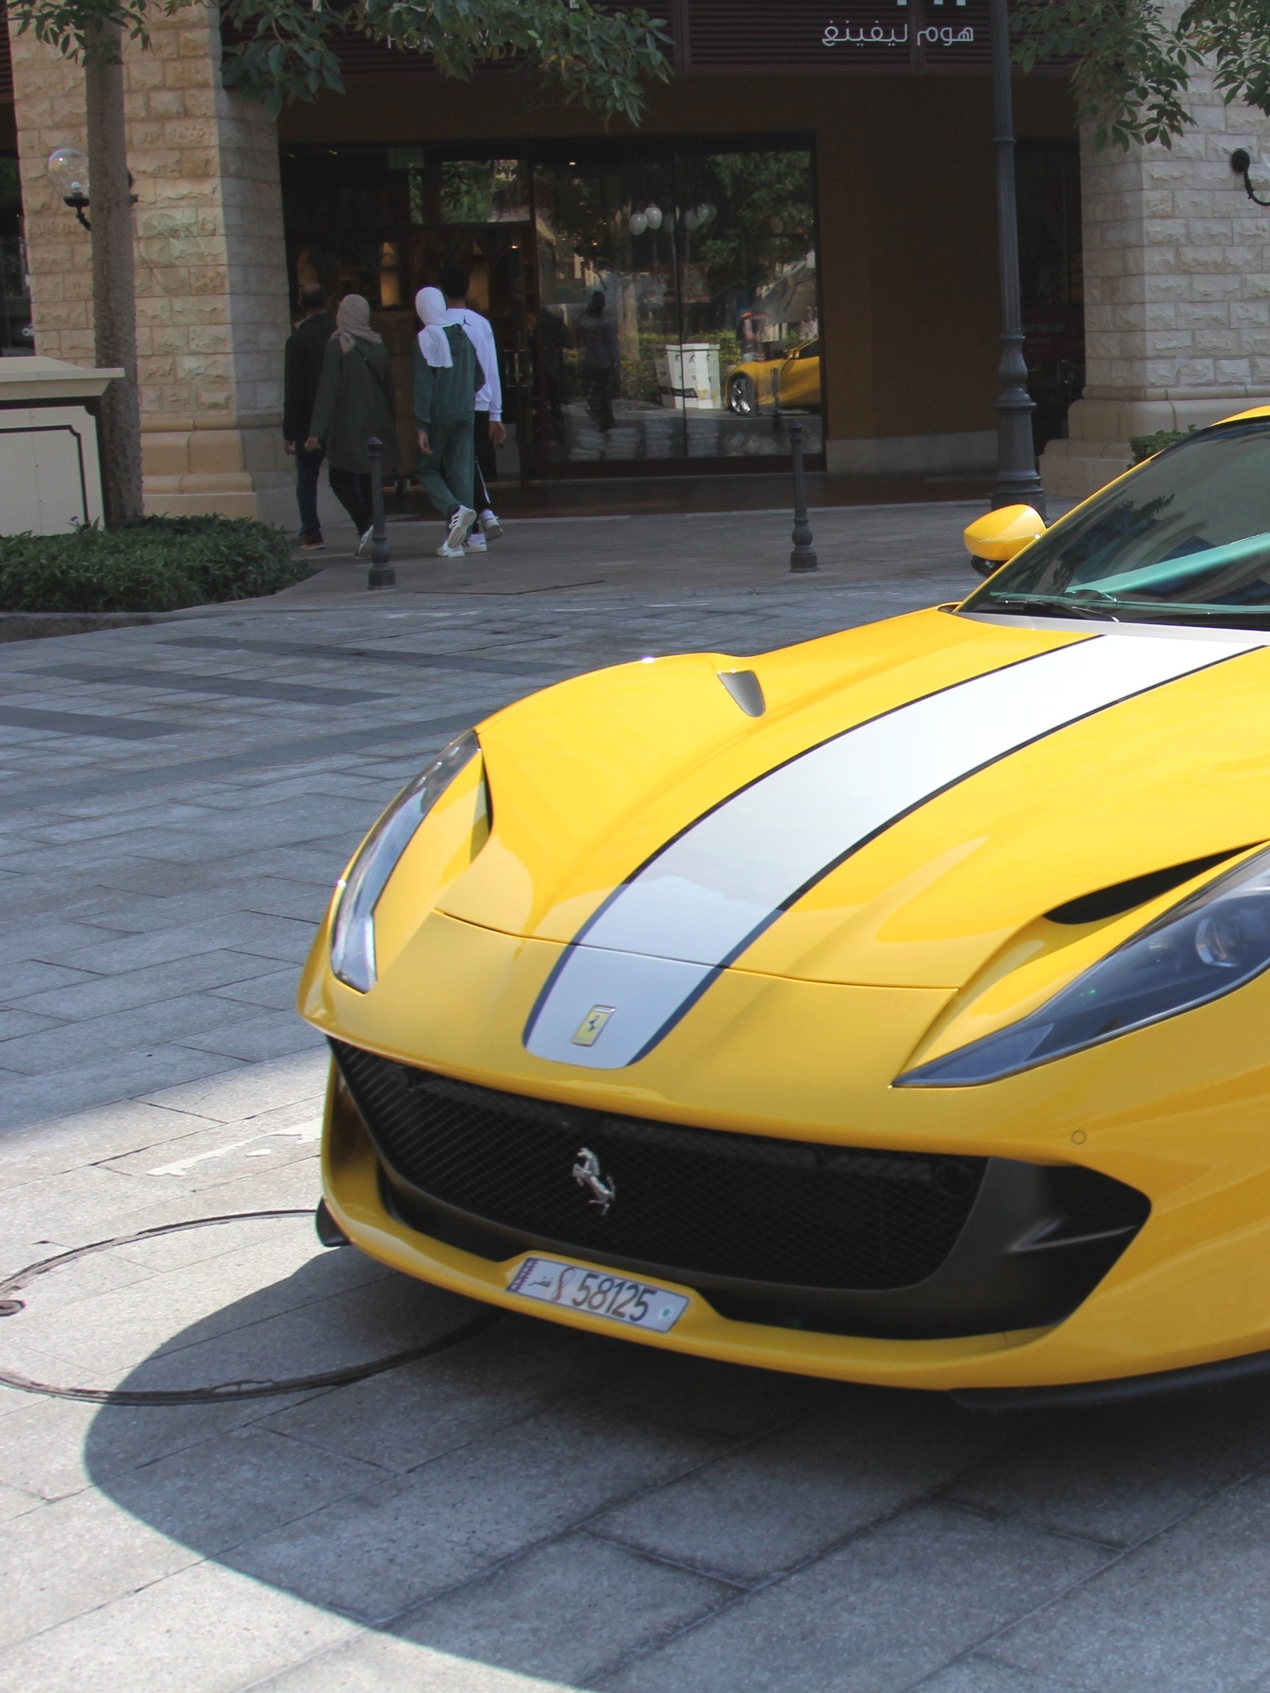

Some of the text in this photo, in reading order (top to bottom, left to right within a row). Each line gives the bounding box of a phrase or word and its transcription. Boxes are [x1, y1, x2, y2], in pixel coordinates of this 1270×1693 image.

[821, 19, 974, 47] هوم ليفينغ
[571, 1273, 658, 1322] 58125
